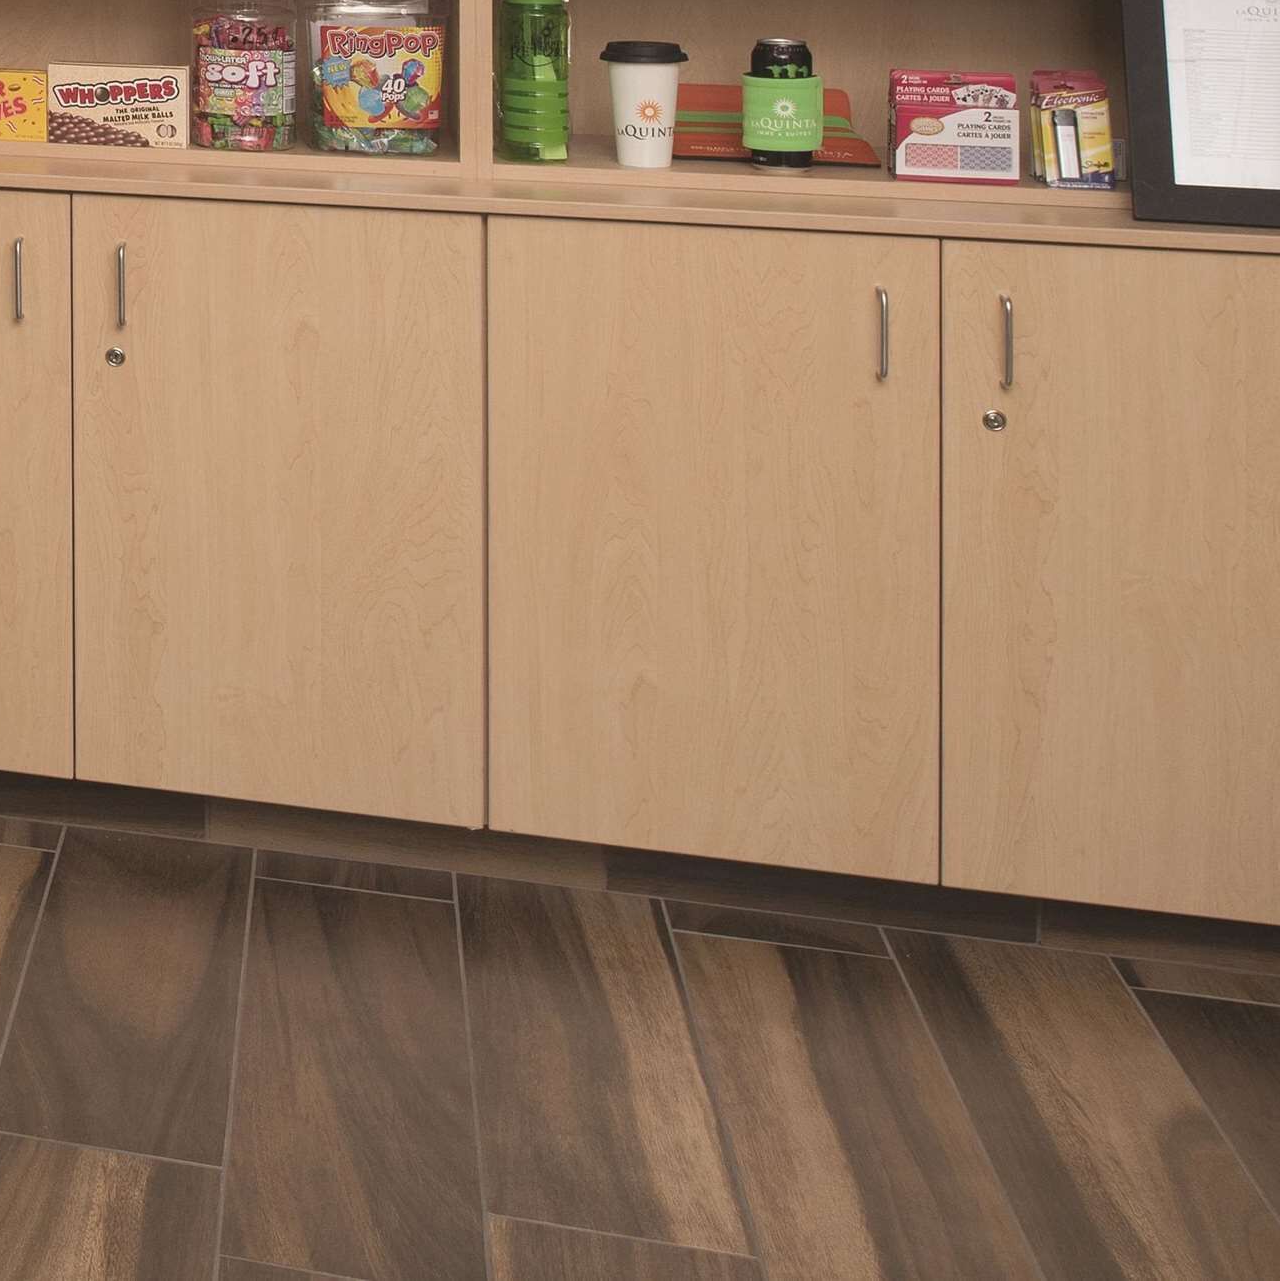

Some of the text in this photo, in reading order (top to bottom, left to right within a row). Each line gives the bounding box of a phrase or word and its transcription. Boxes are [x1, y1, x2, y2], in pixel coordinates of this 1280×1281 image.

[327, 64, 349, 74] NEW
[204, 61, 280, 89] soft
[901, 74, 908, 84] 2
[382, 77, 405, 94] 40
[896, 86, 925, 94] PLAYING
[55, 77, 178, 107] WHOPPERS
[1042, 92, 1102, 108] Electronic
[103, 111, 174, 123] MALTED MILK BALLS
[984, 111, 992, 122] 2
[957, 123, 986, 131] PLAYING
